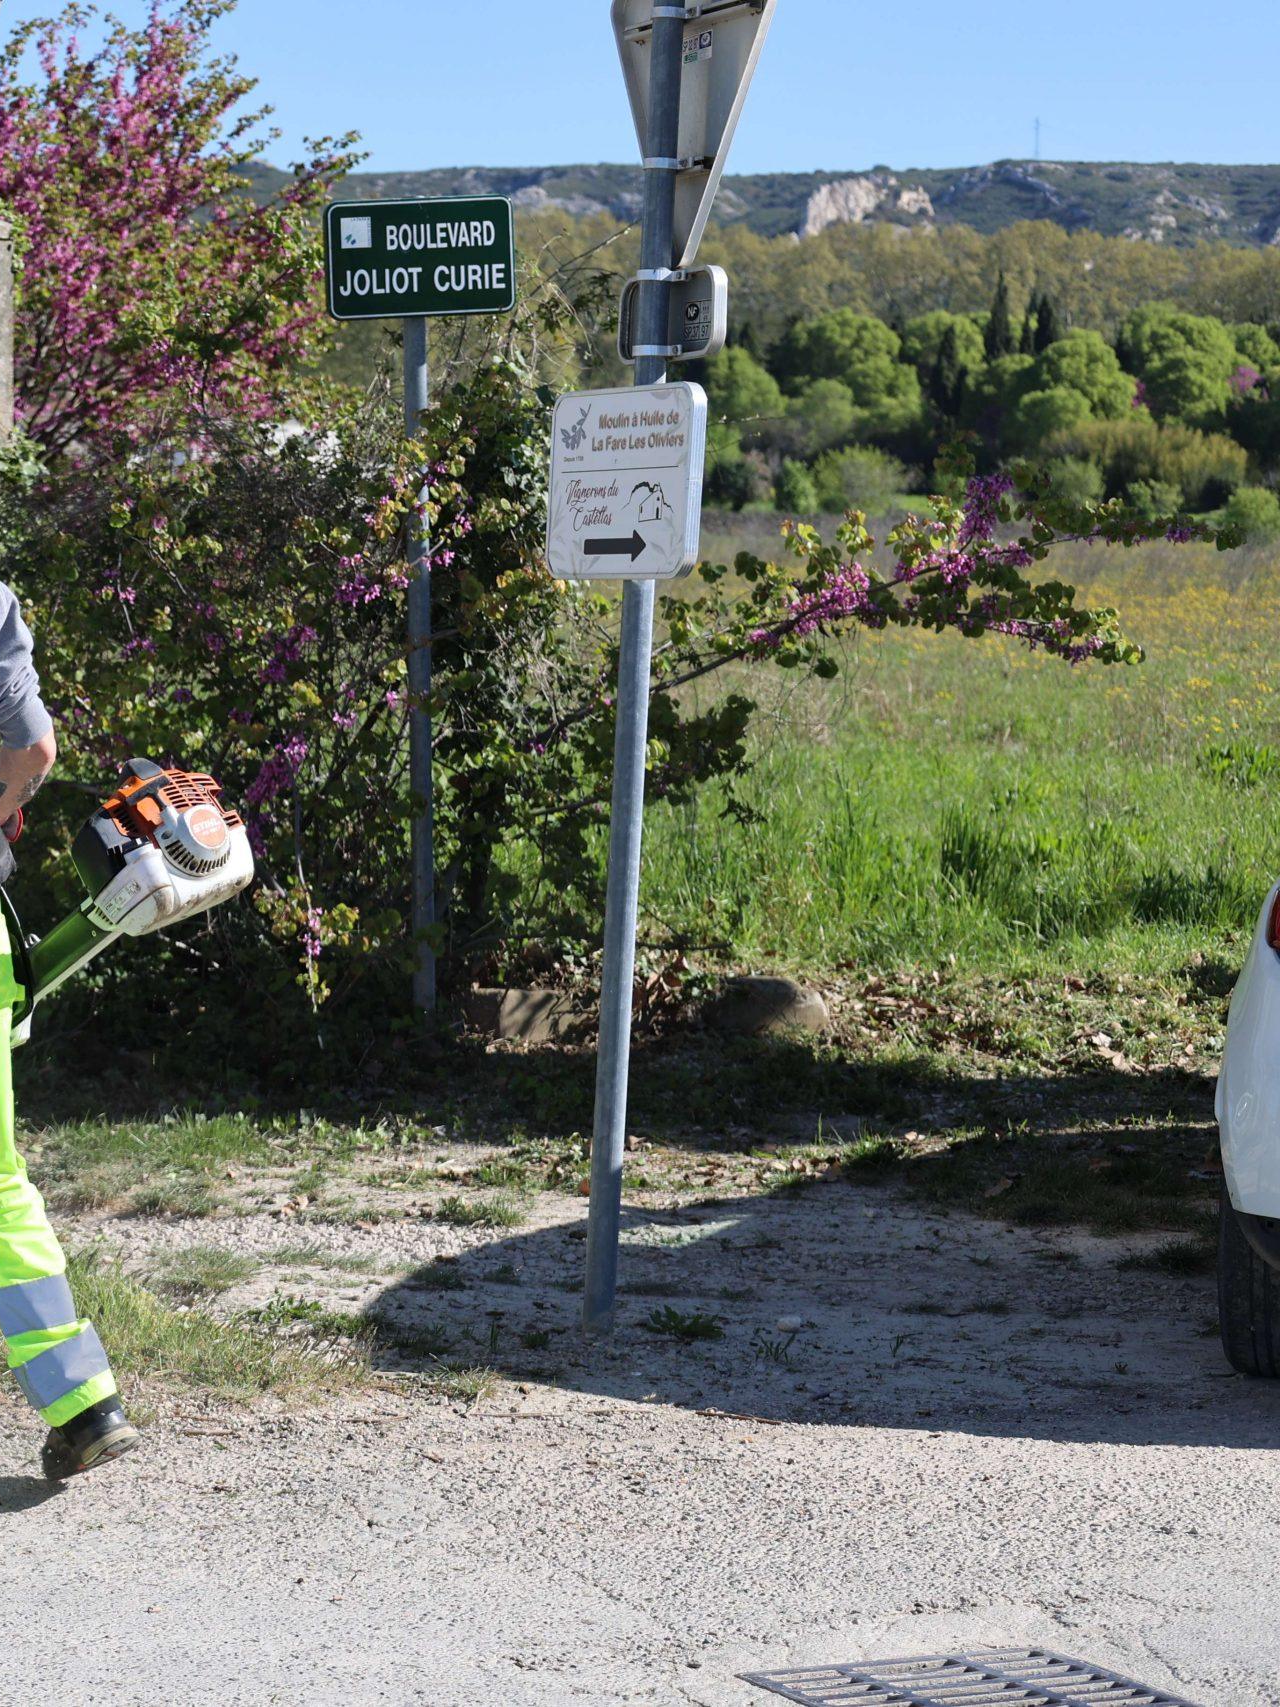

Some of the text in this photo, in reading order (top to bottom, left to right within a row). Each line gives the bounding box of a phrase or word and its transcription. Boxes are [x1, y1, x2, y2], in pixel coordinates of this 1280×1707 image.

[386, 220, 496, 251] BOULEVARD
[339, 263, 506, 297] JOLIOT CURIE
[598, 409, 679, 430] Moulin à Huile de
[591, 431, 684, 452] La Fare Les Oliviers
[565, 478, 619, 506] Vignerons du
